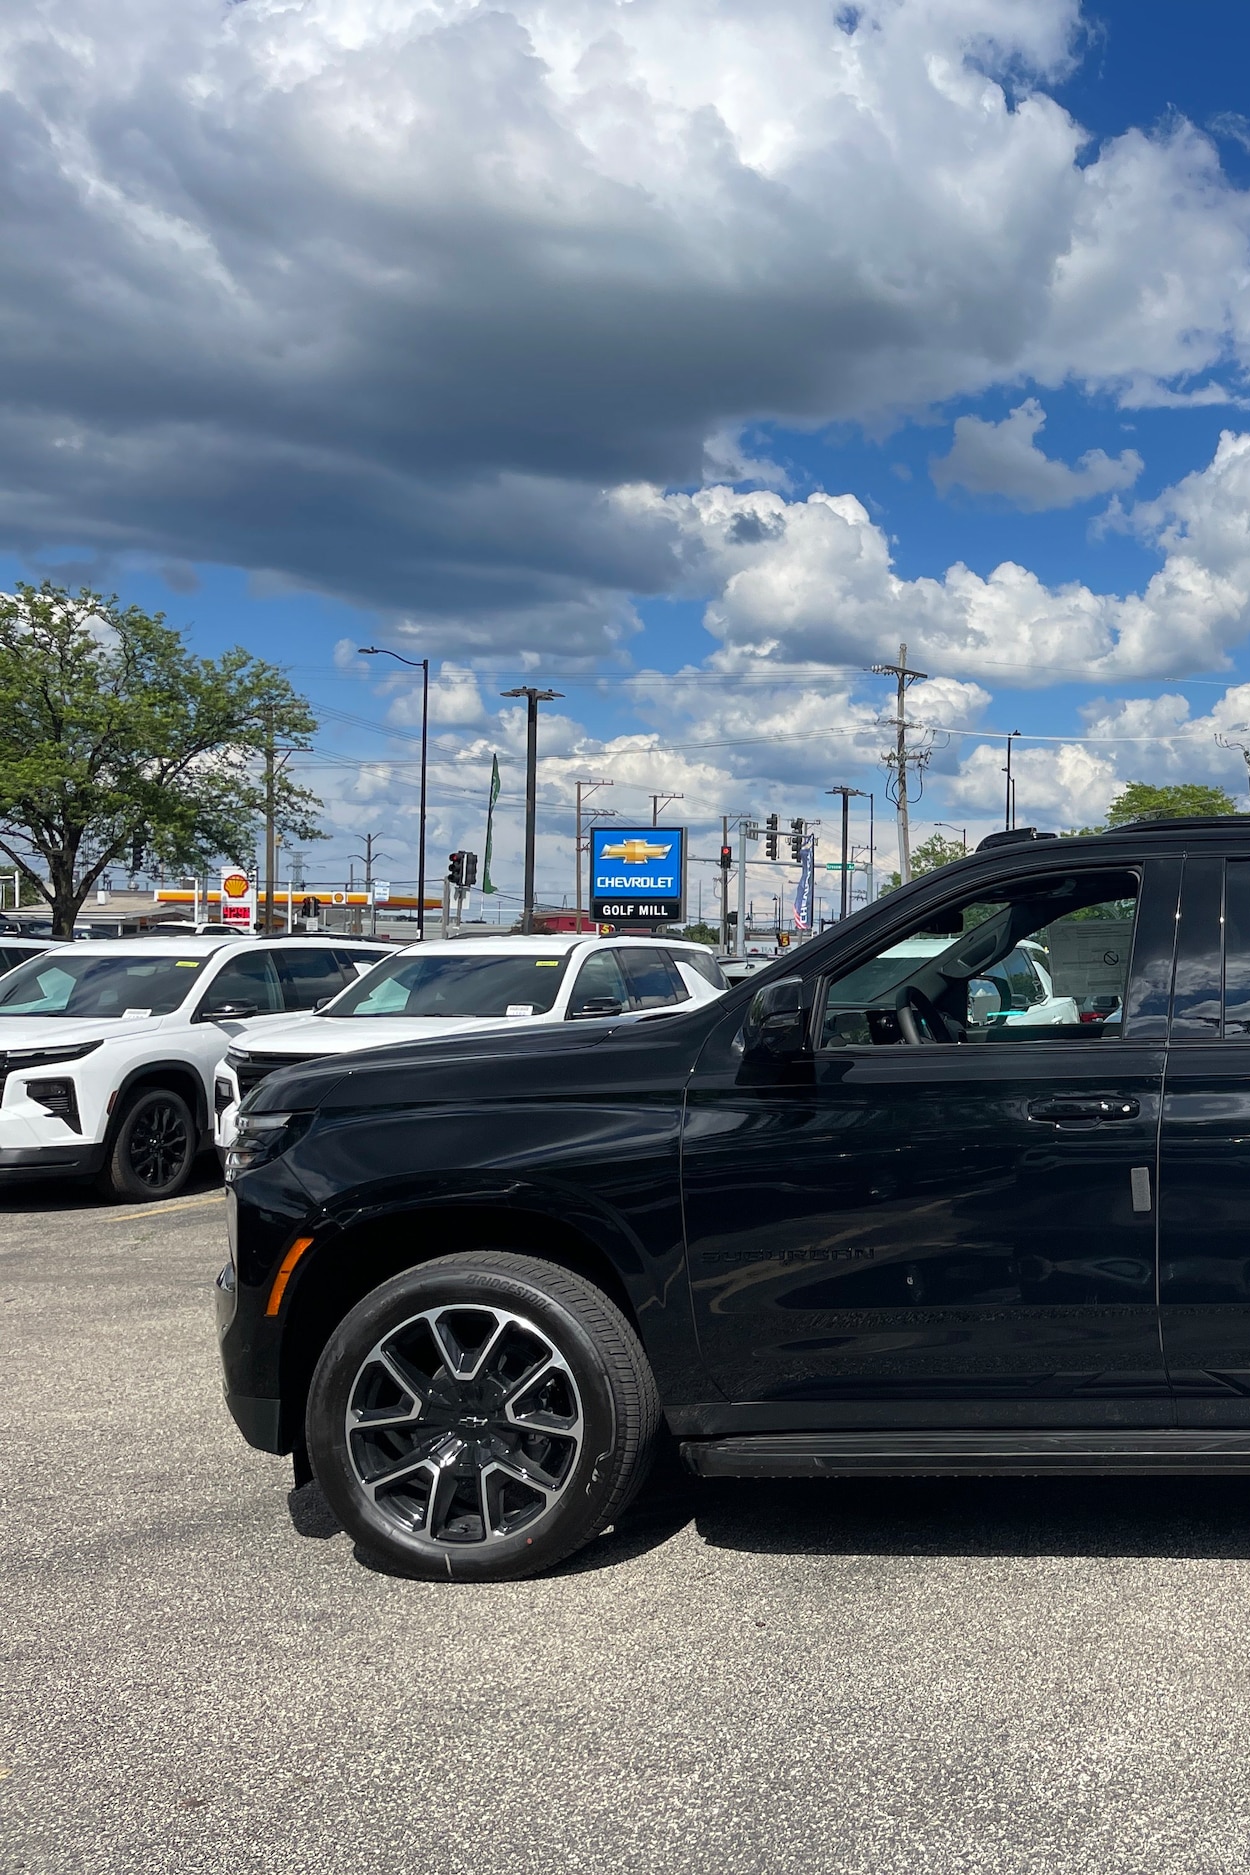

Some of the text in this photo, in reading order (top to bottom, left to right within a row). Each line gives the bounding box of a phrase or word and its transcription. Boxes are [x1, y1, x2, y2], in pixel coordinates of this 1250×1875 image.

[597, 877, 674, 888] CHEVROLET
[602, 905, 668, 916] GOLF MILL
[702, 1248, 875, 1263] SUBURBAN
[465, 1274, 554, 1312] BRIDGESTONE
